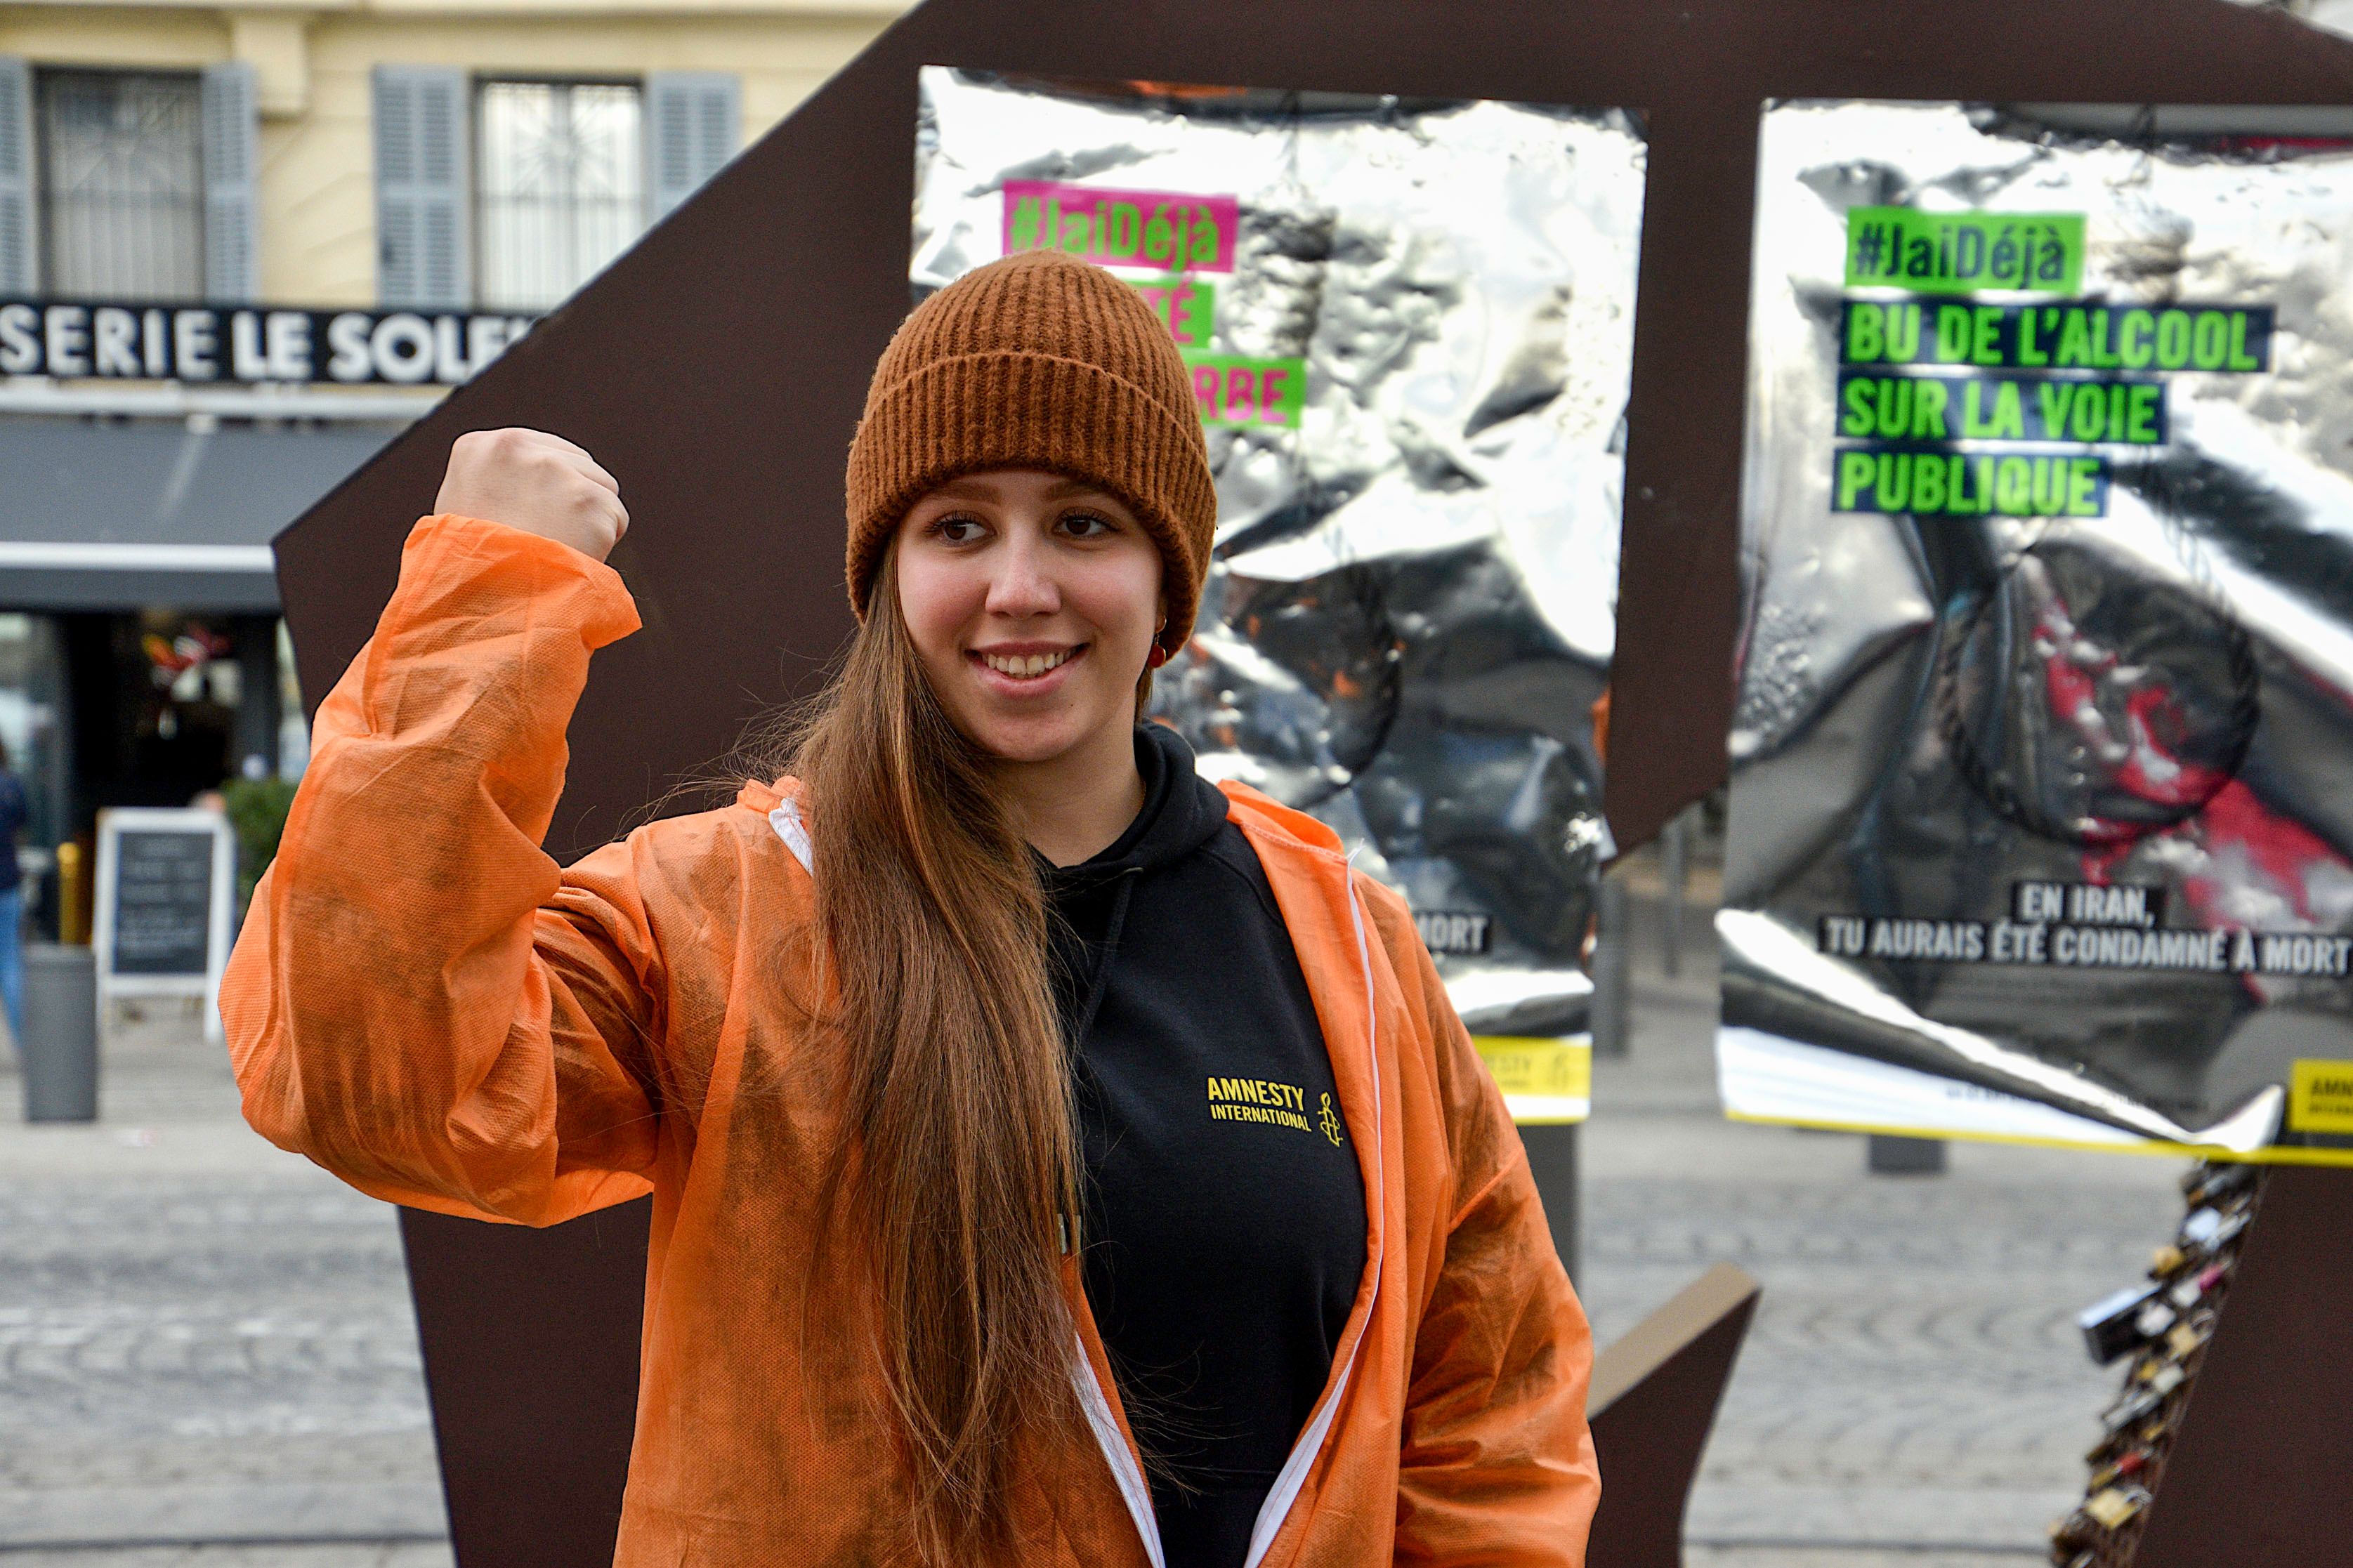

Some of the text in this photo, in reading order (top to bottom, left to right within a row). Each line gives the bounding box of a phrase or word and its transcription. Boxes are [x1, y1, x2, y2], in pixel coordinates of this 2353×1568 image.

[1010, 196, 1219, 273] #JaiDéjà
[1856, 223, 2066, 290] #JaiDéjà
[0, 304, 218, 377] SERIE
[232, 310, 313, 381] LE
[1847, 303, 2258, 371] BU DE L'ALCOOL
[1844, 377, 2161, 444] SUR LA VOIE
[1838, 452, 2102, 518] PUBLIQUE
[2022, 884, 2155, 927] EN IRAN,
[1827, 916, 2349, 974] TU AURAIS ÉTÉ CONDAMNÉ À MORT
[1207, 1077, 1304, 1112] AMNESTY
[1210, 1105, 1312, 1133] INTERNATIONAL
